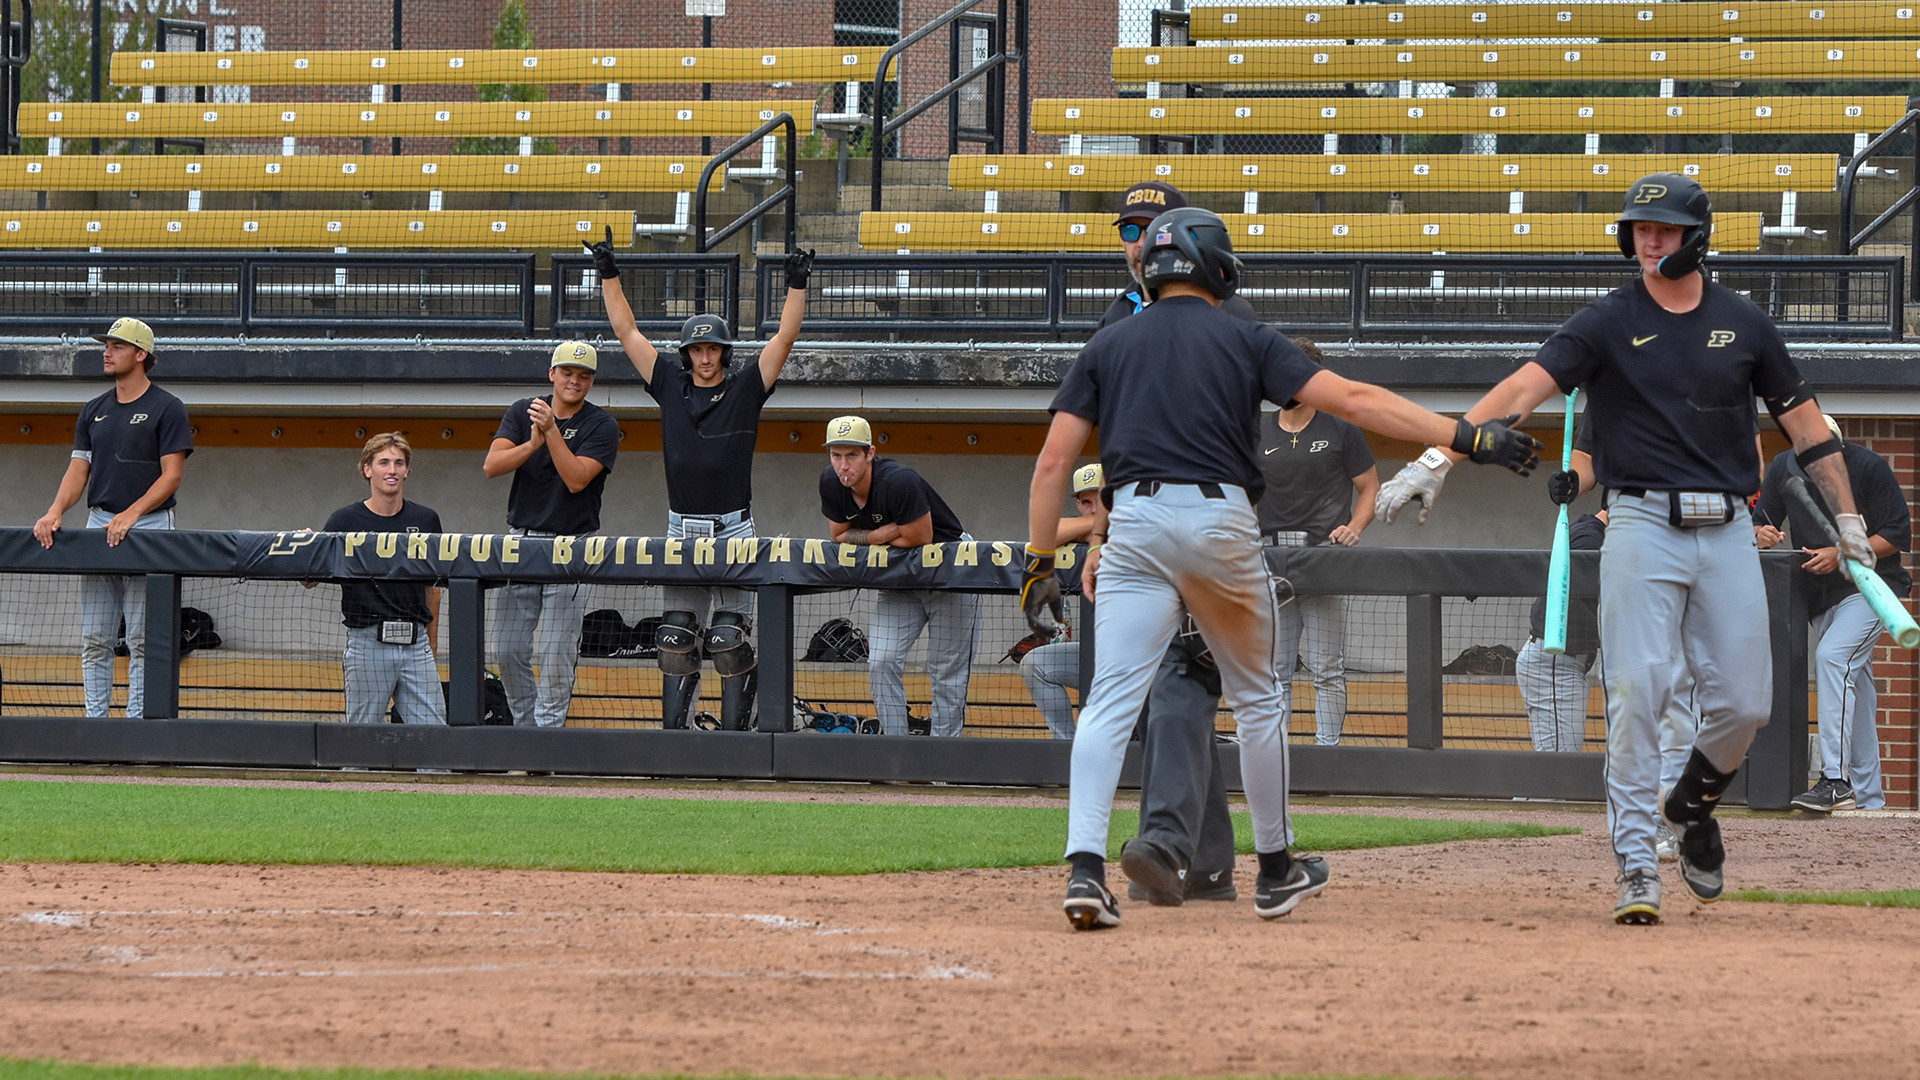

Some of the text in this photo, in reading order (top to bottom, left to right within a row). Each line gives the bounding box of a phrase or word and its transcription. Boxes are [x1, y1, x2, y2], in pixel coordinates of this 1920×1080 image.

[975, 47, 986, 59] 106
[1126, 188, 1167, 206] CBUA
[345, 531, 523, 563] PURDUE
[552, 535, 891, 568] BOILERMAKER
[922, 541, 1078, 570] BASB
